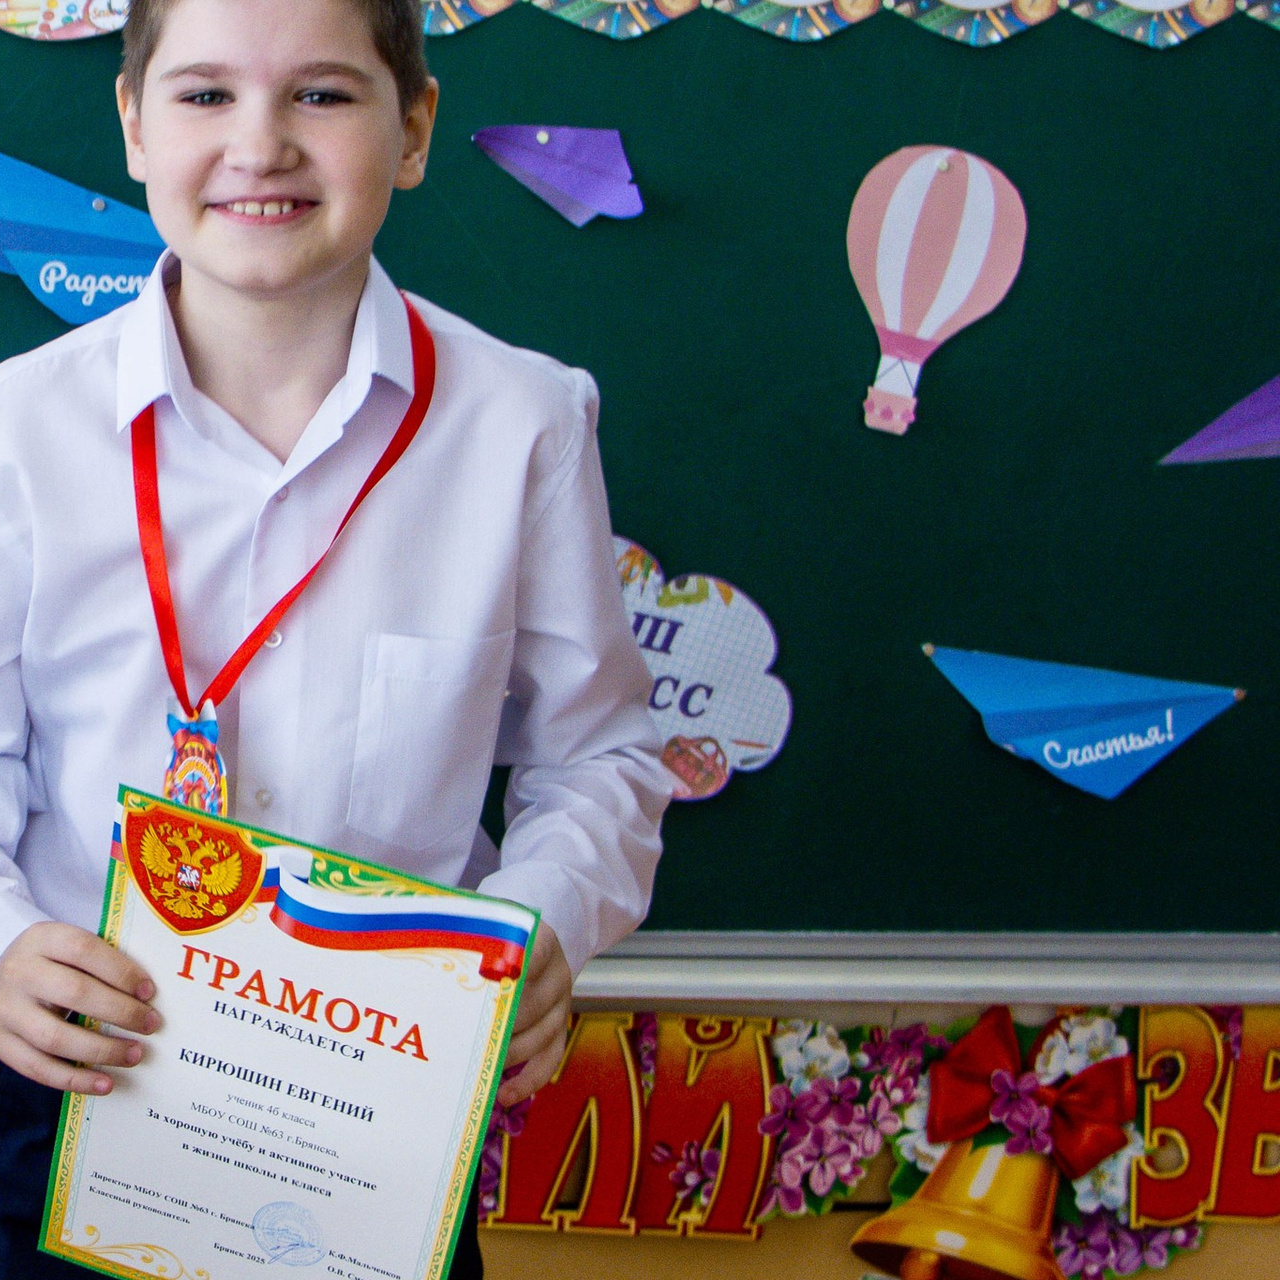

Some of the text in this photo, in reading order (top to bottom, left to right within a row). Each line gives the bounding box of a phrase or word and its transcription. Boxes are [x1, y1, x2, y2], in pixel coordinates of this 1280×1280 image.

[39, 260, 152, 307] Радост
[1043, 708, 1176, 772] Счастья!
[176, 943, 430, 1063] ГРАМОТА
[213, 1000, 366, 1063] НАГРАЖДАЕТСЯ
[178, 1047, 375, 1124] КИРЮШИН ЕВГЕНИЙ
[225, 1093, 265, 1112] ученик
[281, 1111, 317, 1129] класса
[145, 1106, 378, 1192] За хорошую учёбу и активное участие
[190, 1101, 226, 1121] МБОУ
[228, 1113, 258, 1132] СОШ
[259, 1123, 285, 1140] №63
[181, 1142, 333, 1198] в жизни школы и класса
[88, 1185, 192, 1226] Классный руководитель
[90, 1170, 132, 1191] Директор
[132, 1184, 163, 1199] МБОУ
[163, 1194, 189, 1209] СОШ
[189, 1202, 210, 1216] №63
[219, 1212, 256, 1231] Брянска
[213, 1241, 267, 1266] Брянск 2025
